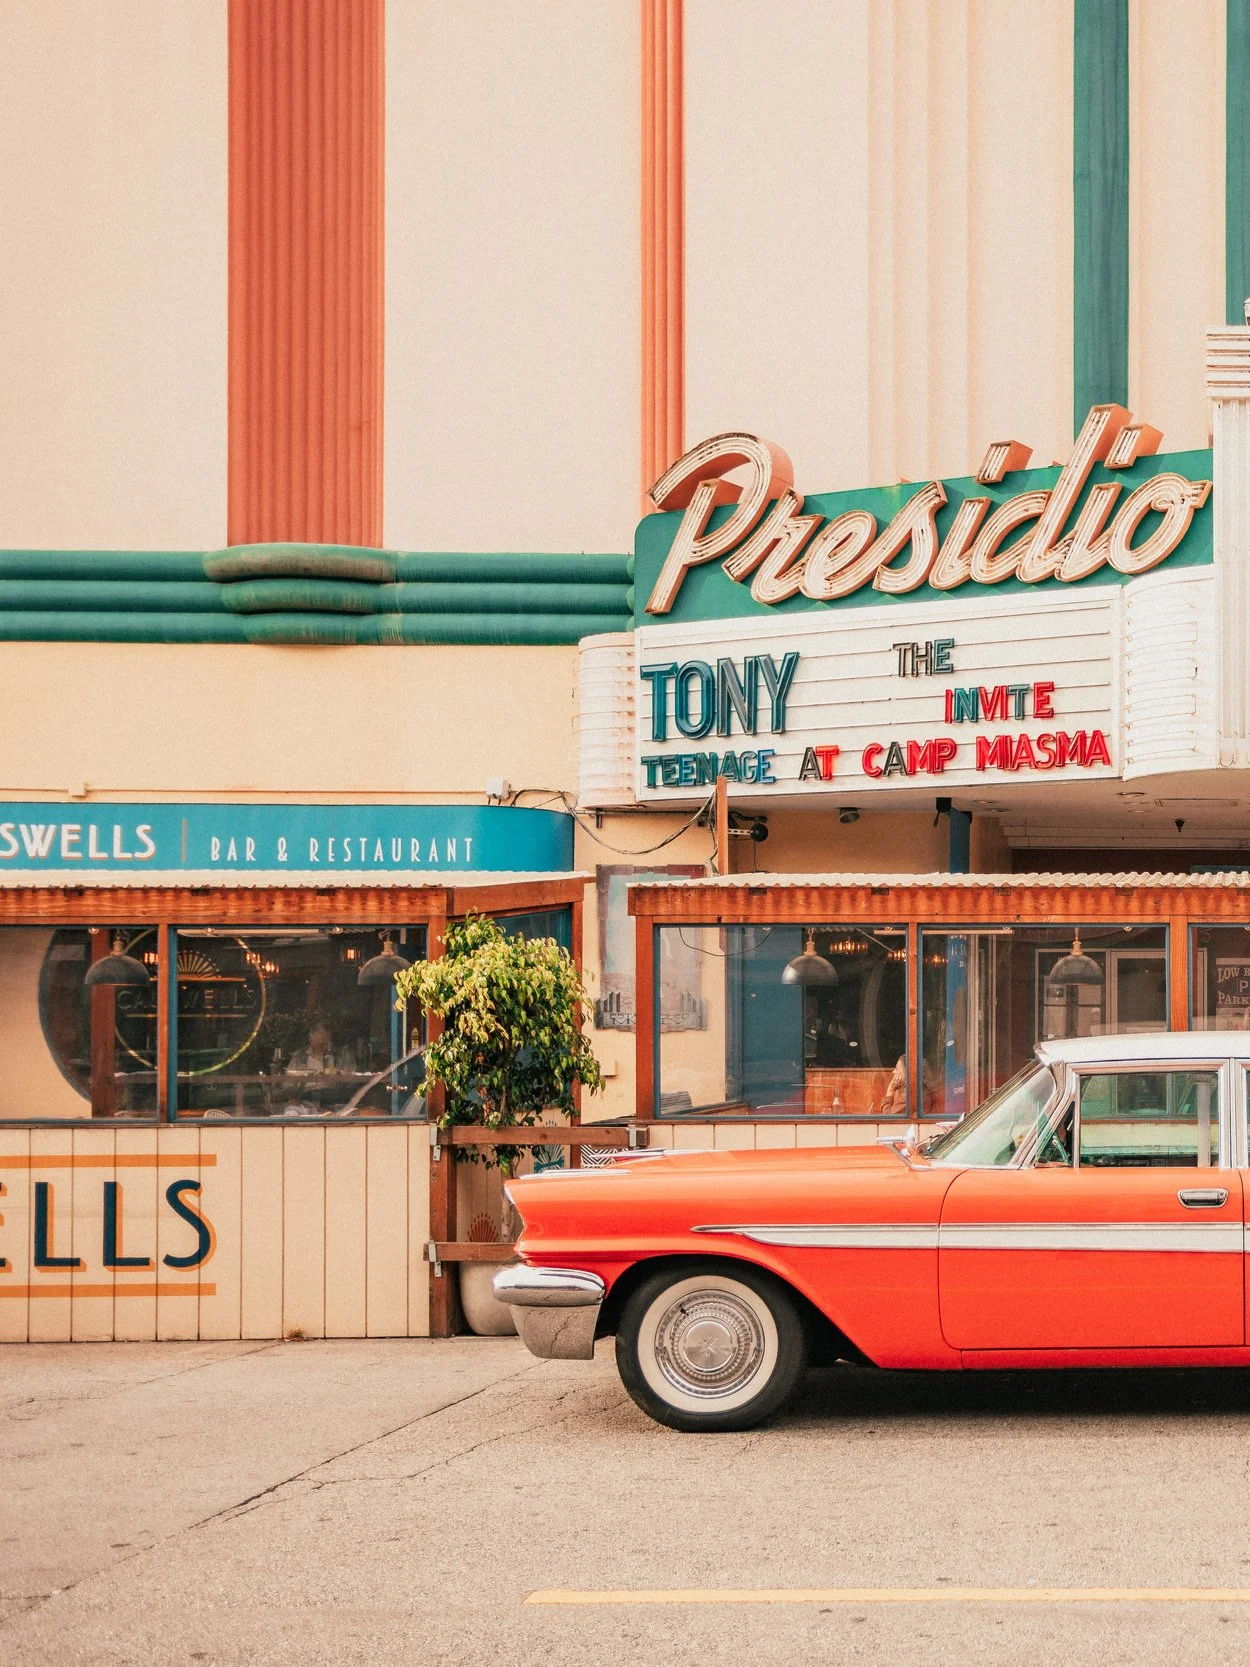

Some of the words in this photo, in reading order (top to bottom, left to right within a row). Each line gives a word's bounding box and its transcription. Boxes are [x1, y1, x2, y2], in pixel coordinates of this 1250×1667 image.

[646, 404, 1212, 614] Presidio
[892, 637, 955, 679] THE
[640, 651, 800, 742] TONY
[944, 681, 1055, 724] INVITE
[640, 747, 776, 789] TEENAGE
[799, 743, 840, 782] AT
[862, 736, 958, 778] CAMP
[975, 729, 1111, 773] MIASMA
[0, 823, 156, 861] SWELLS
[211, 836, 256, 861] BAR
[277, 837, 289, 862] &
[309, 837, 473, 863] RESTAURANT
[1217, 967, 1240, 984] LOW
[0, 1179, 217, 1273] LLS
